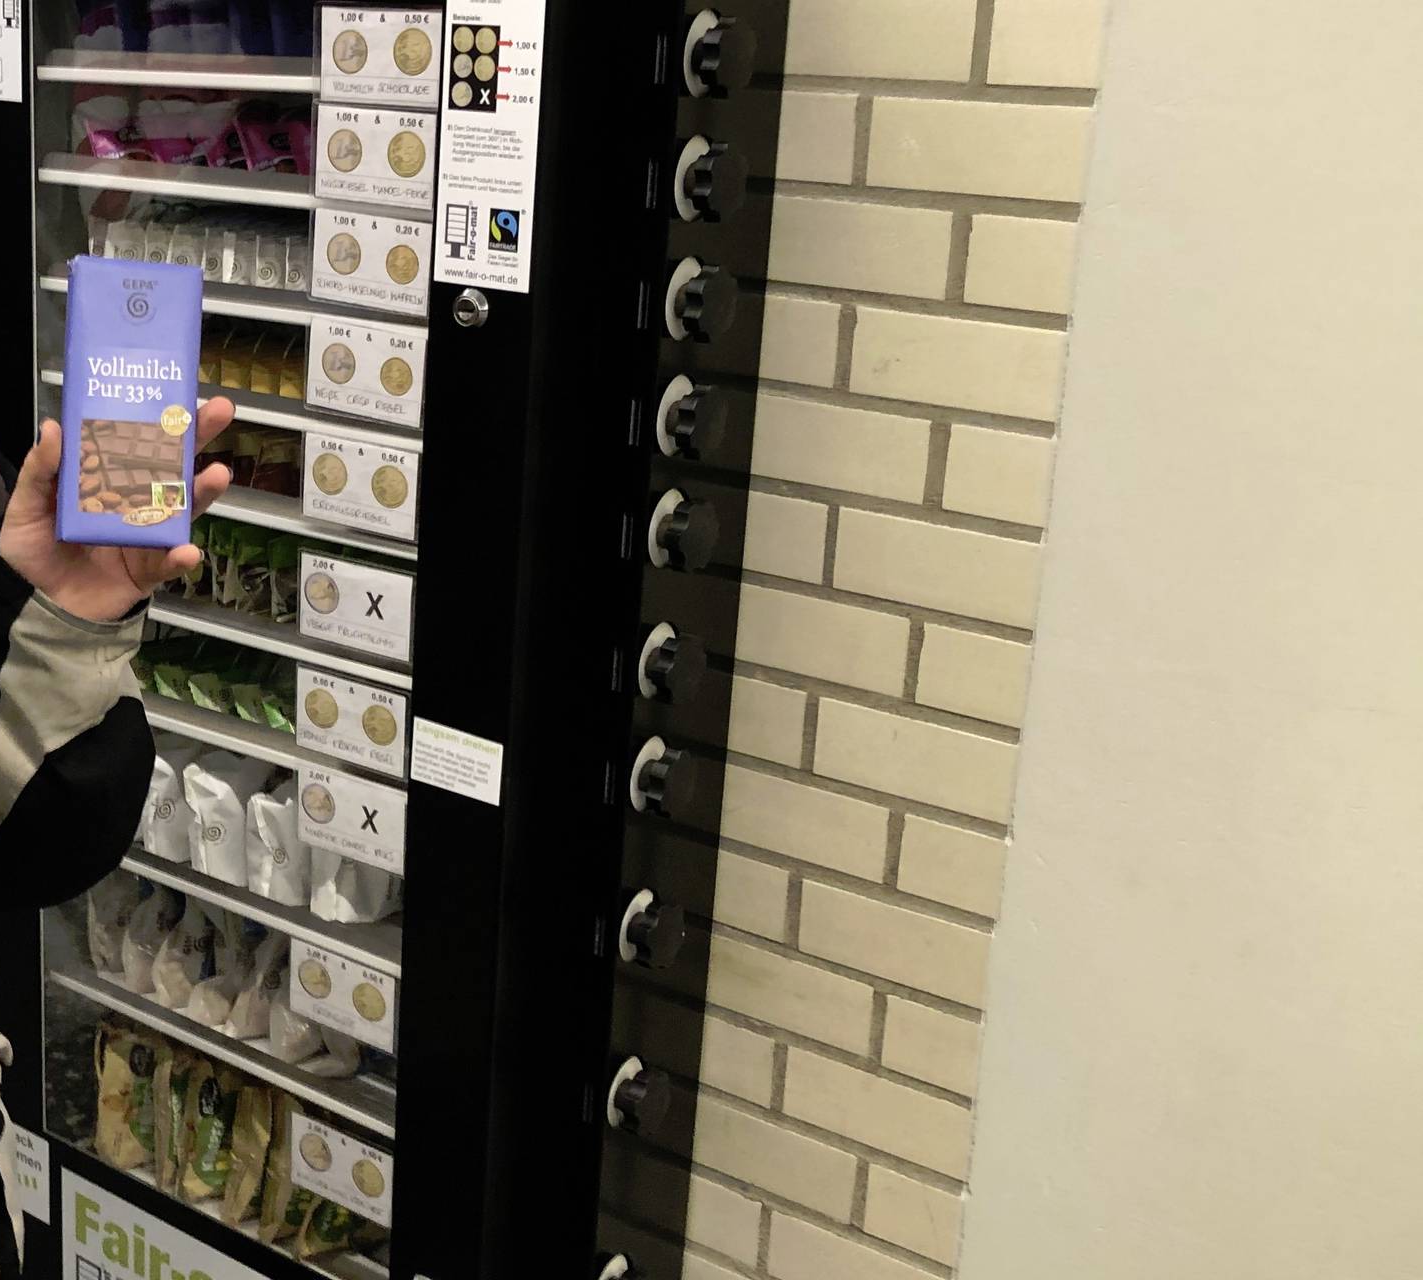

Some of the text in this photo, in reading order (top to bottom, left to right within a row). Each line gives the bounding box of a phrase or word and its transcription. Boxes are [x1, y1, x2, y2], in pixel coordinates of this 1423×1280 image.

[341, 12, 356, 22] 1,00
[405, 14, 422, 24] 0,50
[516, 41, 530, 49] 1,00
[515, 67, 529, 76] 1,50
[512, 95, 527, 104] 2,00
[336, 112, 351, 122] 1,00
[399, 118, 416, 128] 0,50
[333, 215, 349, 226] 1,00
[395, 224, 412, 236] 0,20
[328, 326, 344, 336] 1,00
[390, 338, 406, 349] 0,20
[87, 356, 182, 381] Vollmilch
[87, 378, 162, 404] Pur 33%
[321, 440, 337, 451] 0,50
[381, 453, 398, 464] 0,50
[313, 559, 328, 570] 2,00
[365, 591, 384, 620] X
[361, 805, 378, 835] X
